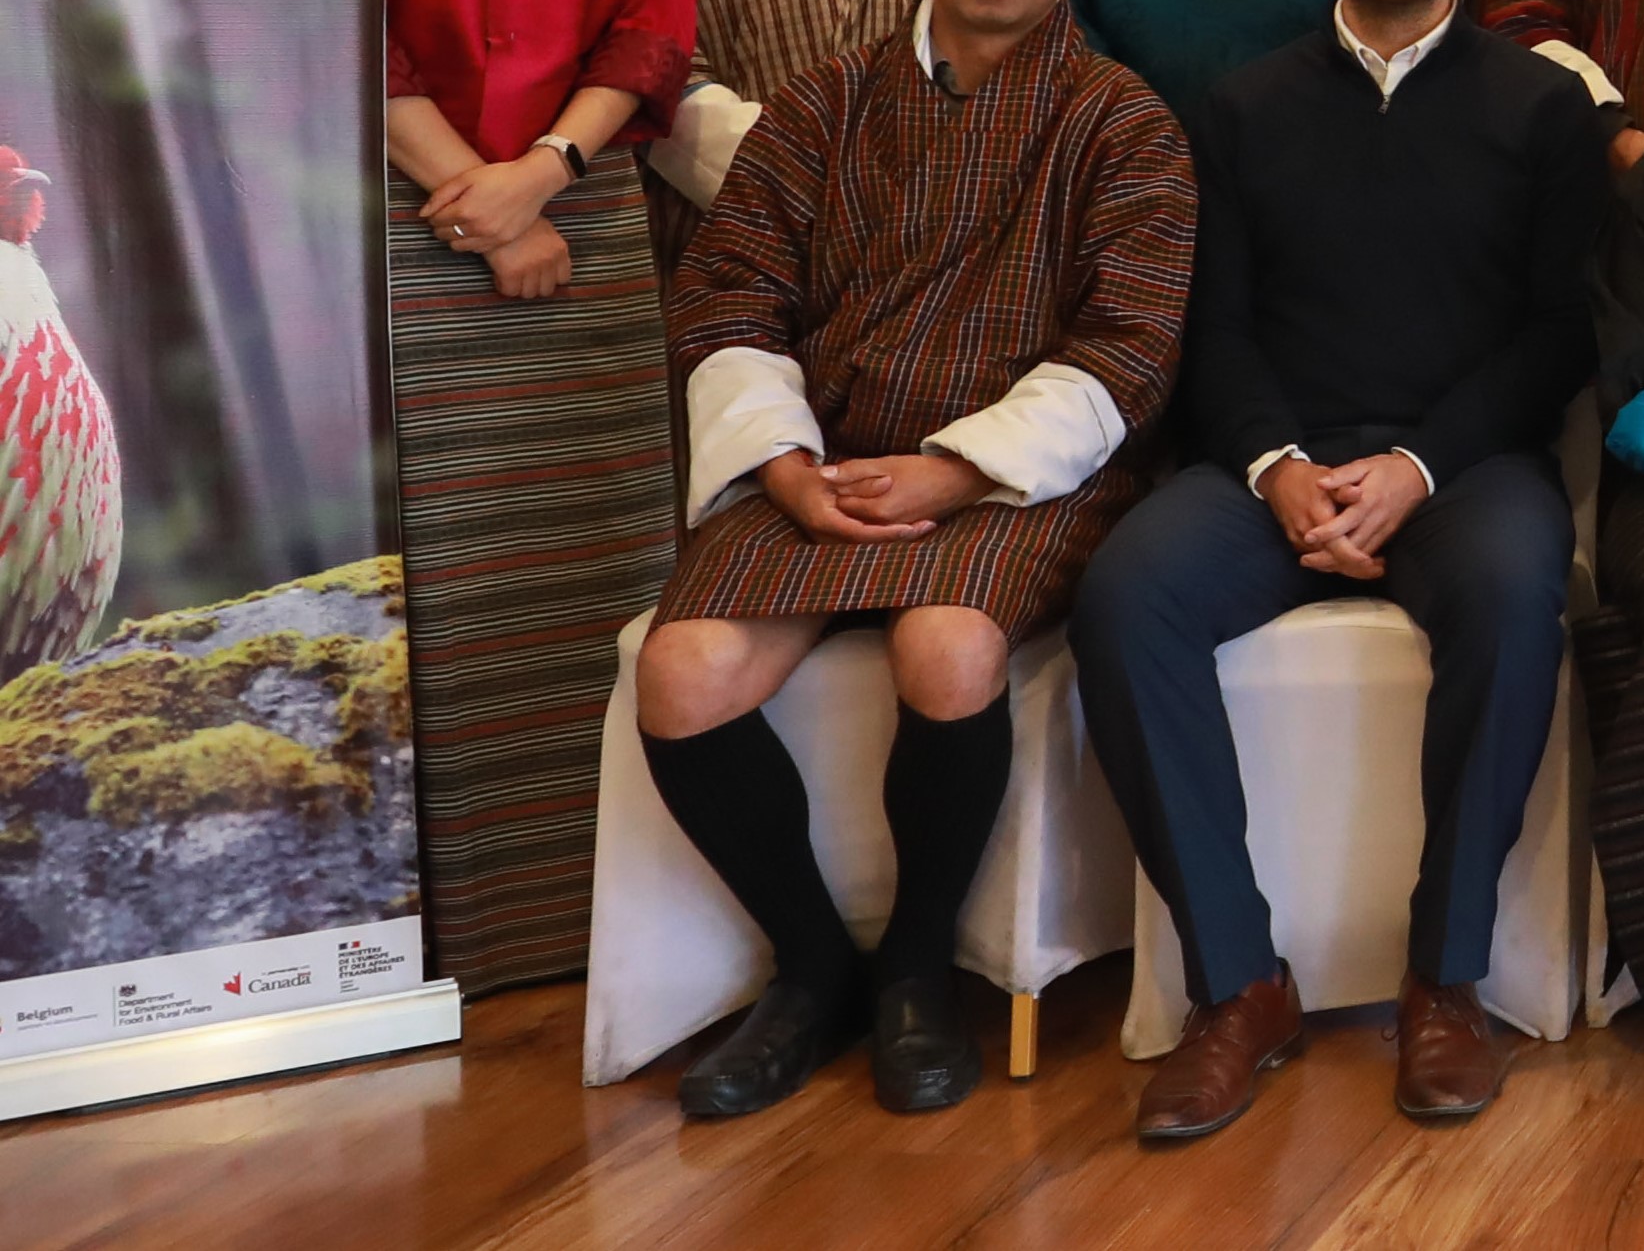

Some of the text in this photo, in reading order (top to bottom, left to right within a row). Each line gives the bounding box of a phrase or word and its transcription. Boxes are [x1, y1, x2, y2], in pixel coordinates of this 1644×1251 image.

[248, 972, 312, 994] Canada
[118, 992, 175, 1008] Department
[134, 998, 193, 1015] Environment
[17, 1006, 74, 1022] Belgium
[118, 1016, 144, 1026] Food
[155, 1009, 180, 1020] Rural
[182, 1004, 213, 1015] Affairs
